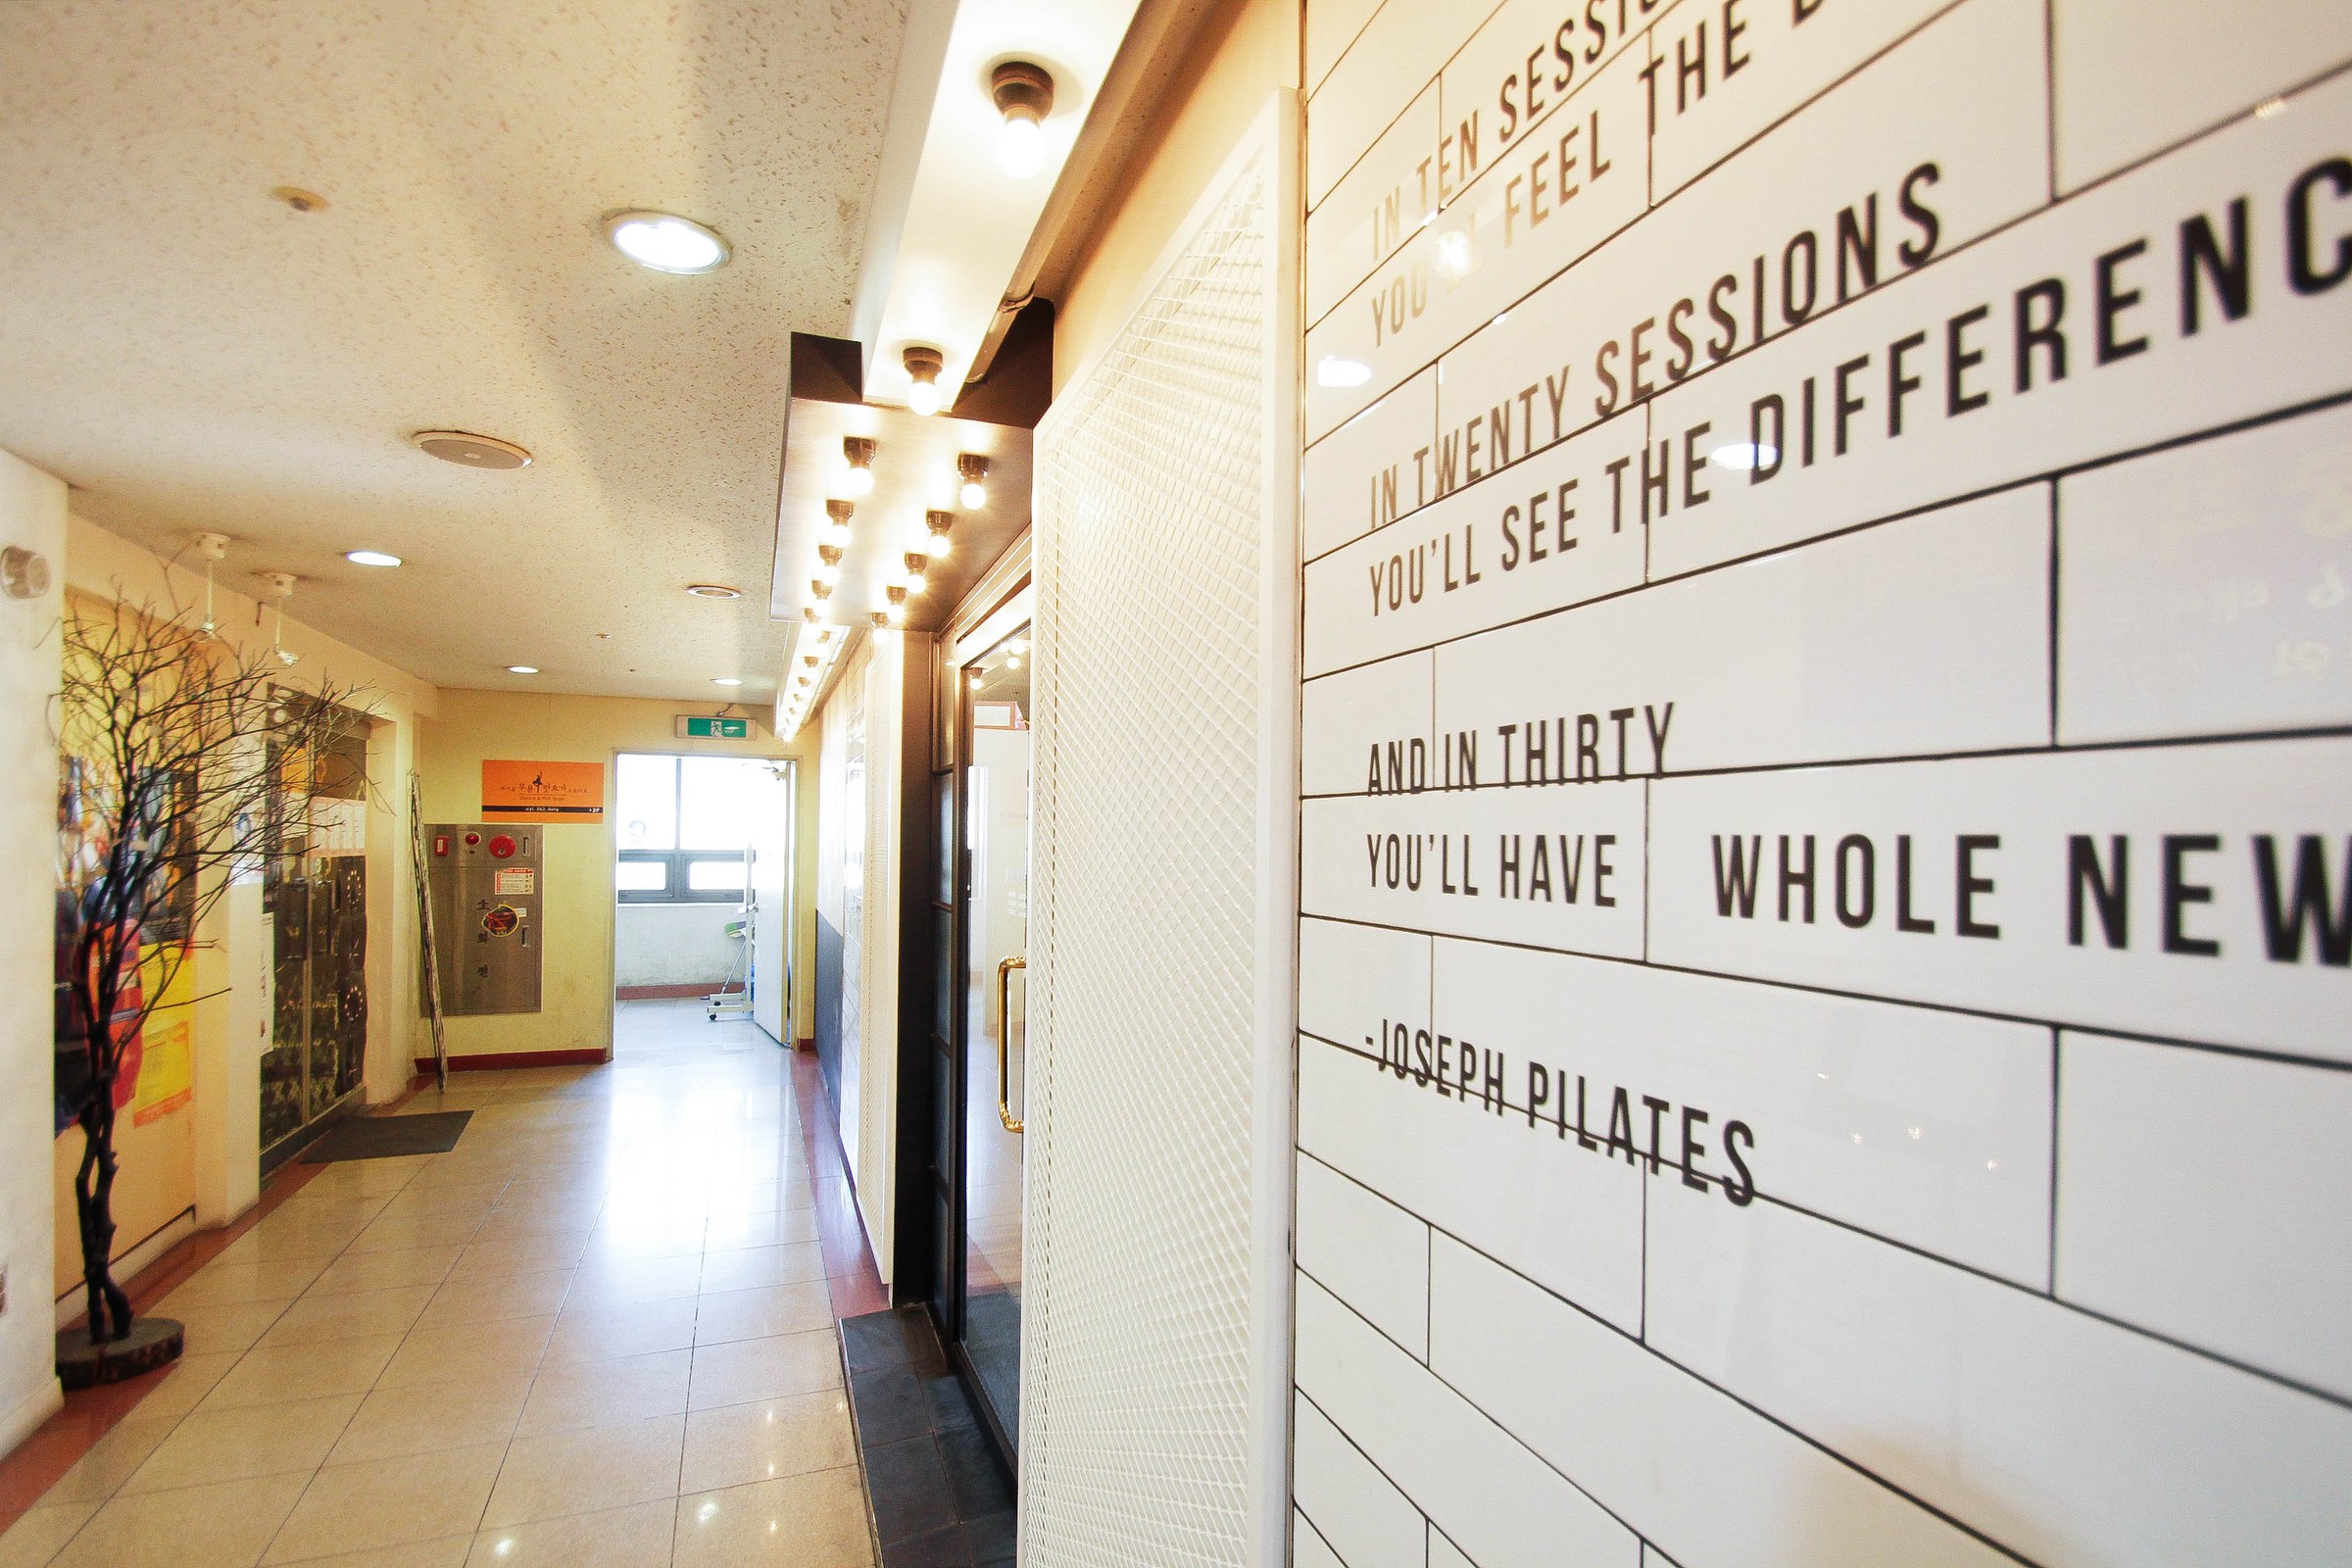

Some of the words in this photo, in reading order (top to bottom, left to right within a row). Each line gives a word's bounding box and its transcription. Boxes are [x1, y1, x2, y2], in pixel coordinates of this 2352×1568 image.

[1372, 186, 1400, 263] IN
[1416, 109, 1479, 218] TEN
[1503, 110, 1611, 248] FEEL
[1639, 0, 1751, 135] THE
[1370, 464, 1398, 530] IN
[1413, 364, 1571, 502] TWENTY
[1594, 161, 1940, 418] SESSIONS
[1369, 524, 1482, 617] YOU'LL
[1500, 478, 1579, 572] SEE
[1604, 421, 1711, 535] THE
[1368, 738, 1426, 797] AND
[1445, 729, 1478, 792] IN
[1497, 702, 1675, 789] THIRTY
[1367, 833, 1479, 897] YOU'LL
[1499, 834, 1617, 908] HAVE
[1711, 833, 2001, 941] WHOLE
[2067, 833, 2352, 968] NEW
[1528, 1060, 1755, 1207] PILATES
